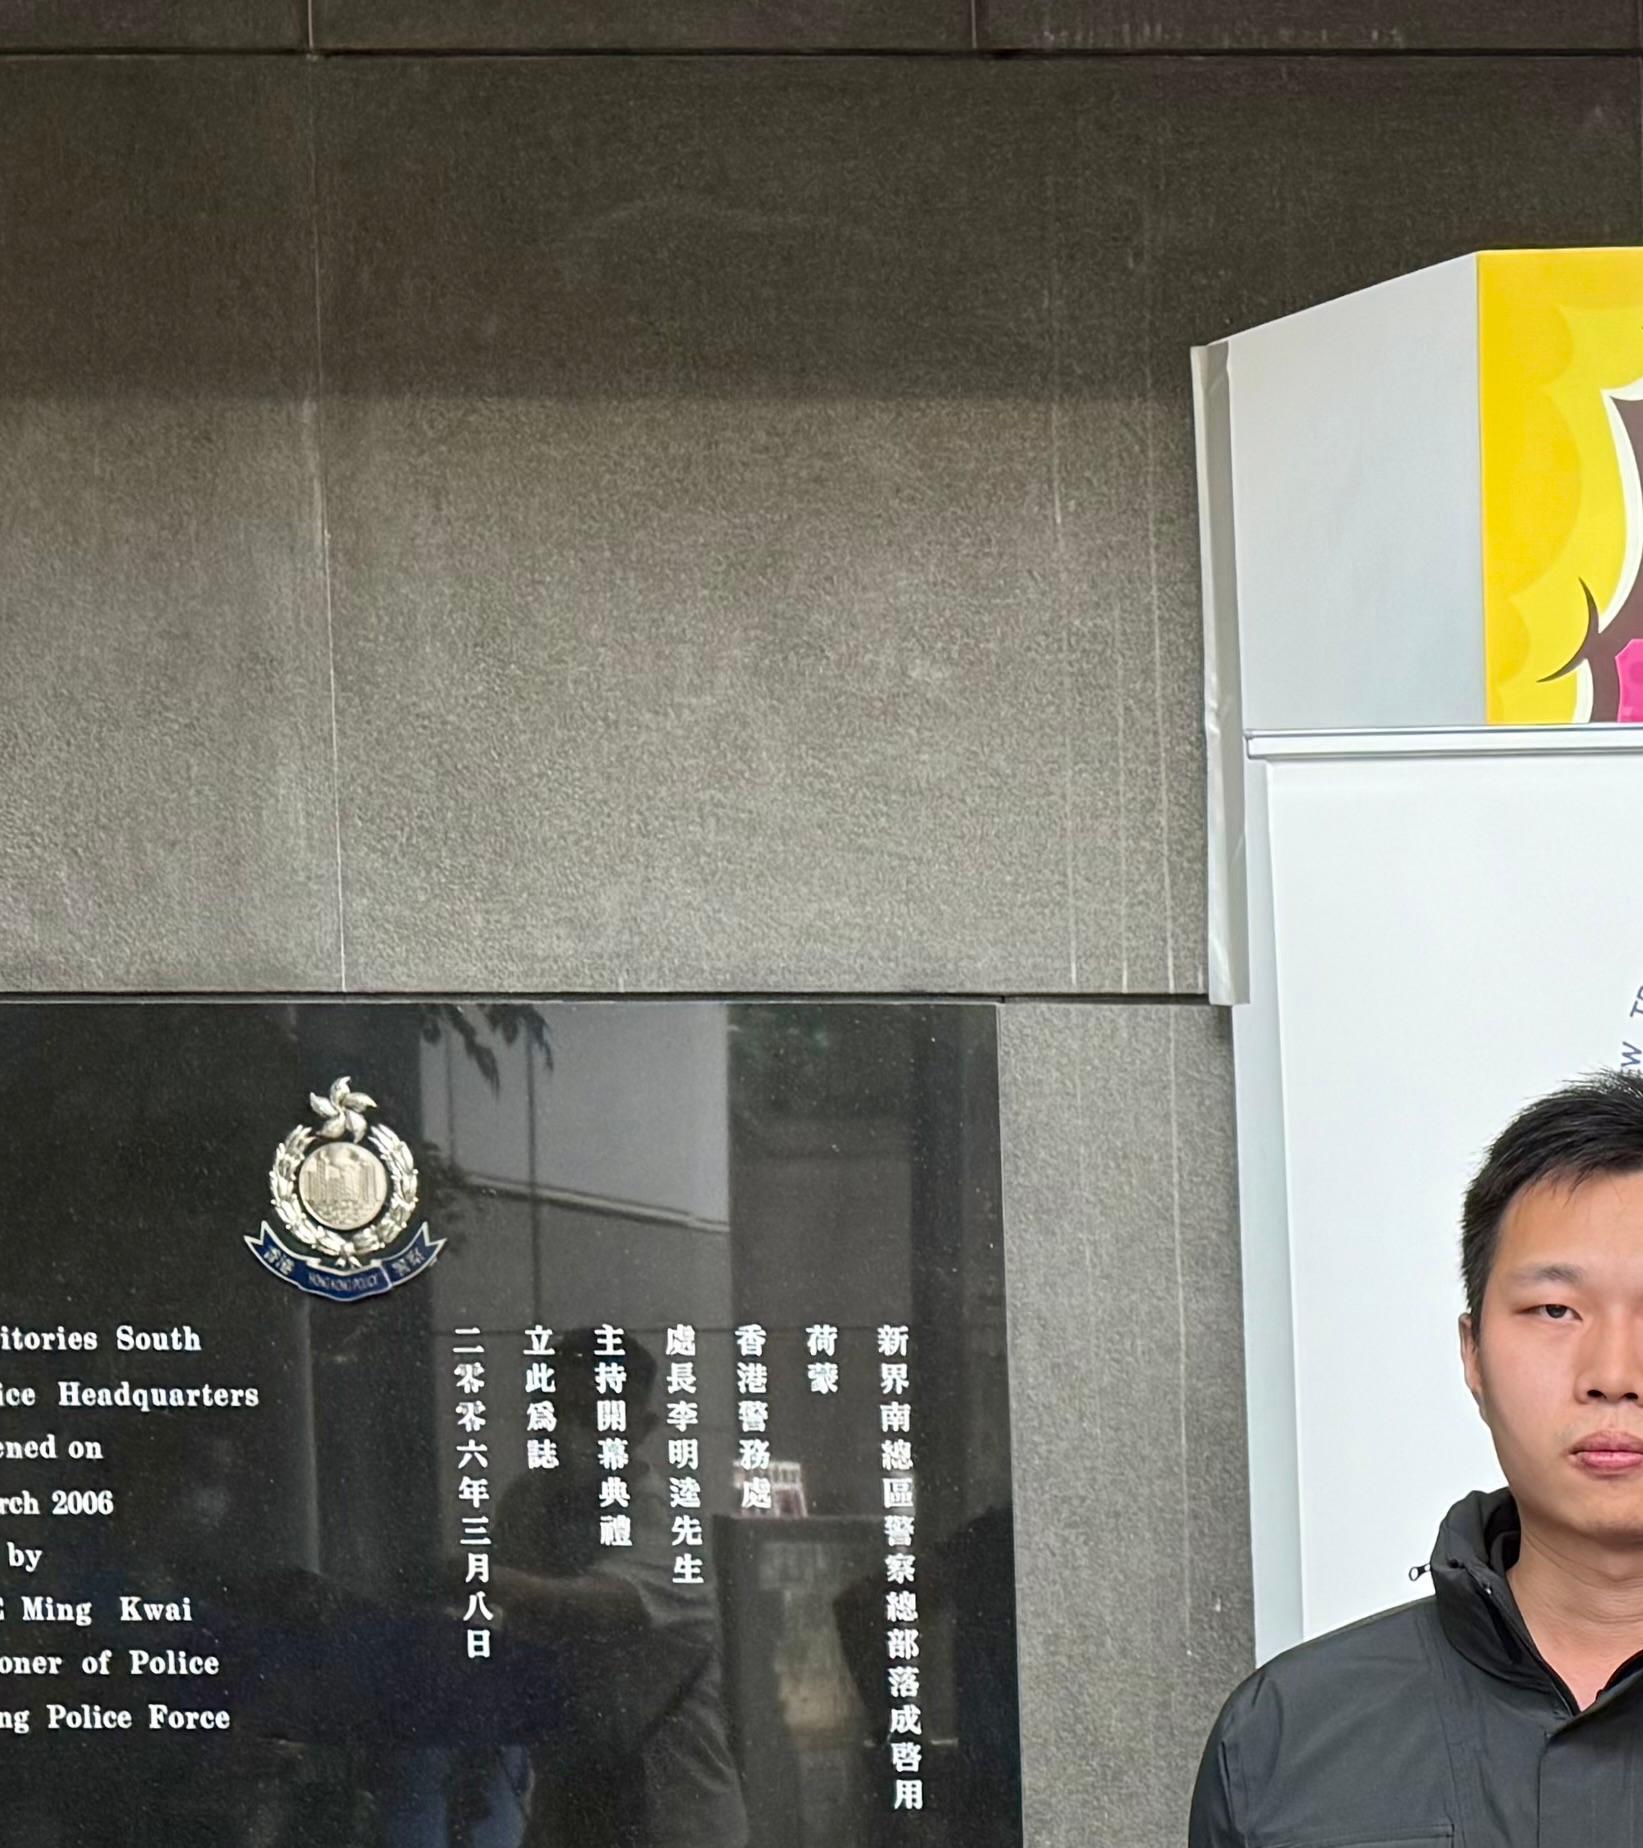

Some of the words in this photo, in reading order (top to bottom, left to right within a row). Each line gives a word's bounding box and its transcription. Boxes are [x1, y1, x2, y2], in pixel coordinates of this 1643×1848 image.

[117, 1326, 201, 1350] South
[805, 1324, 839, 1394] 荷蒙
[58, 1382, 258, 1411] Headquarters
[734, 1323, 772, 1510] 香港警務處
[594, 1323, 633, 1547] 主持開幕典禮
[69, 1441, 103, 1459] on
[665, 1323, 705, 1584] 處長李明逵先生
[52, 1490, 113, 1514] 2006
[452, 1327, 494, 1661] 二零零六年三月八日
[7, 1542, 42, 1572] by
[21, 1597, 91, 1626] Ming
[120, 1597, 192, 1621] Kwai
[82, 1650, 112, 1674] of
[129, 1650, 219, 1674] Police
[47, 1704, 131, 1728] Police
[149, 1704, 229, 1729] Force
